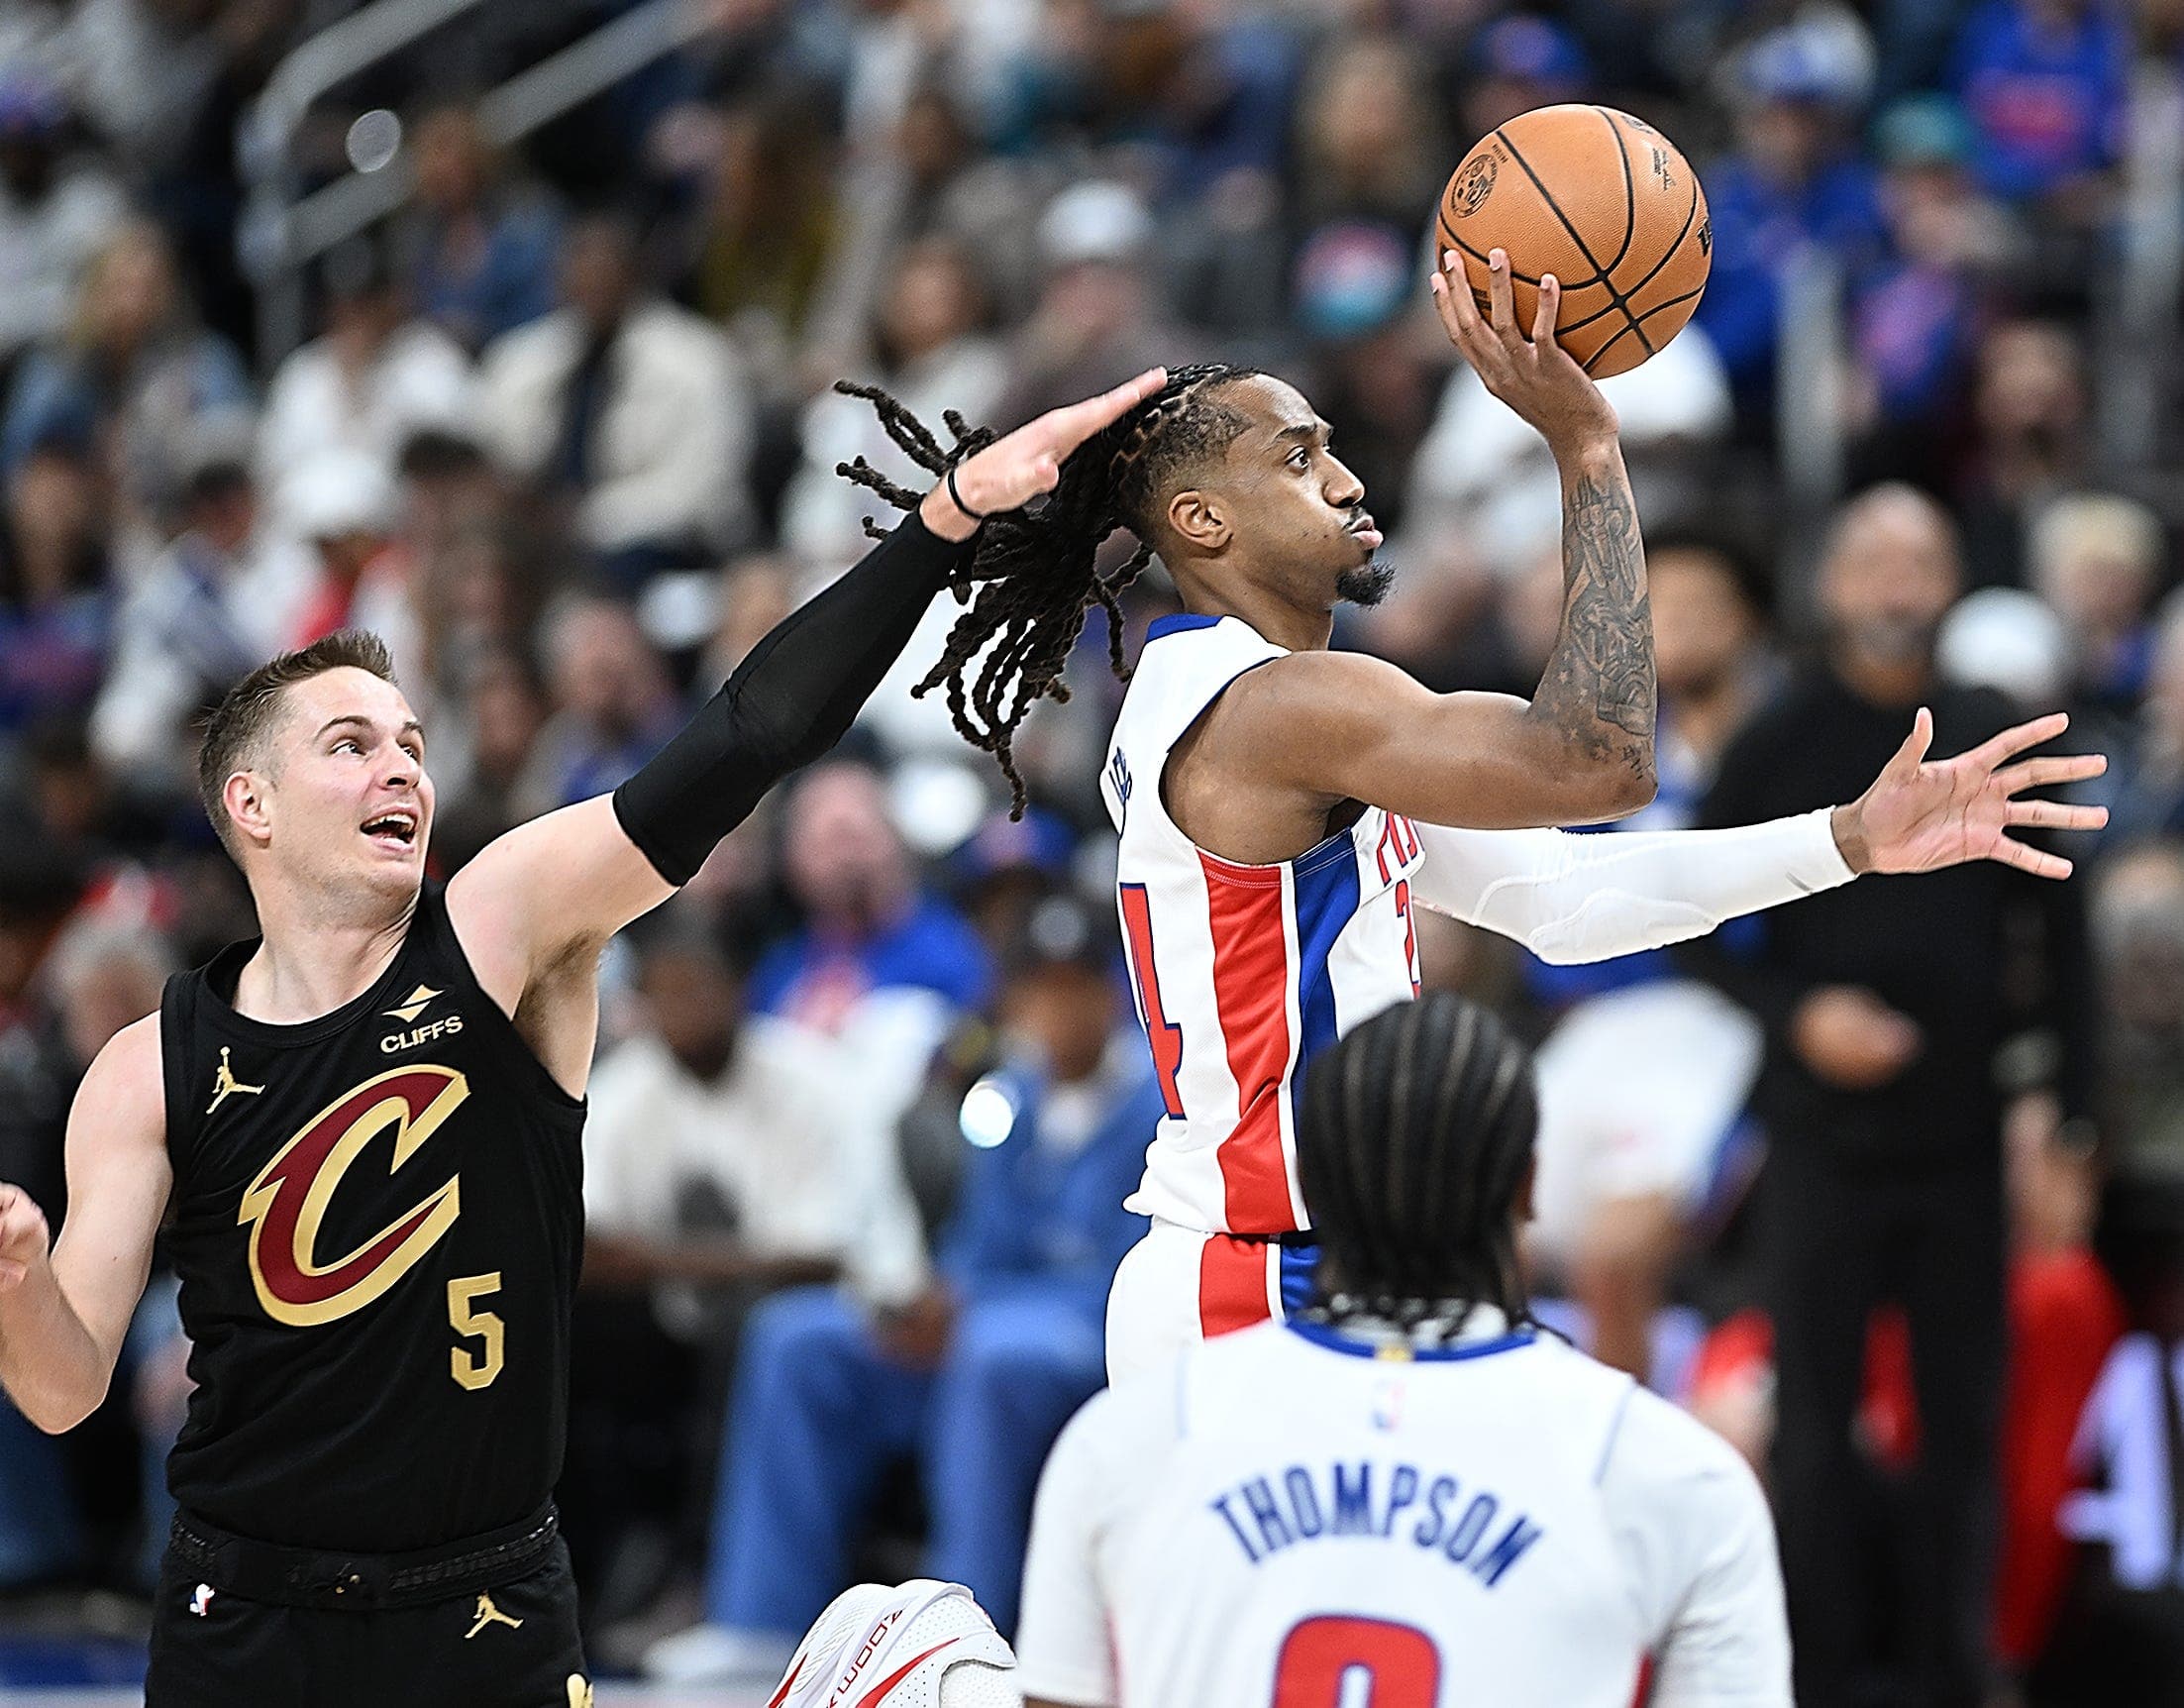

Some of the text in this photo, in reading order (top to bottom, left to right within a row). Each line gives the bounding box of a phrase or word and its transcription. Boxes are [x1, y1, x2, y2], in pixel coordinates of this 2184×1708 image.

[380, 1015, 464, 1053] CLIFFS
[237, 1064, 471, 1327] C
[448, 1271, 505, 1391] 5
[1210, 1462, 1543, 1588] THOMPSON
